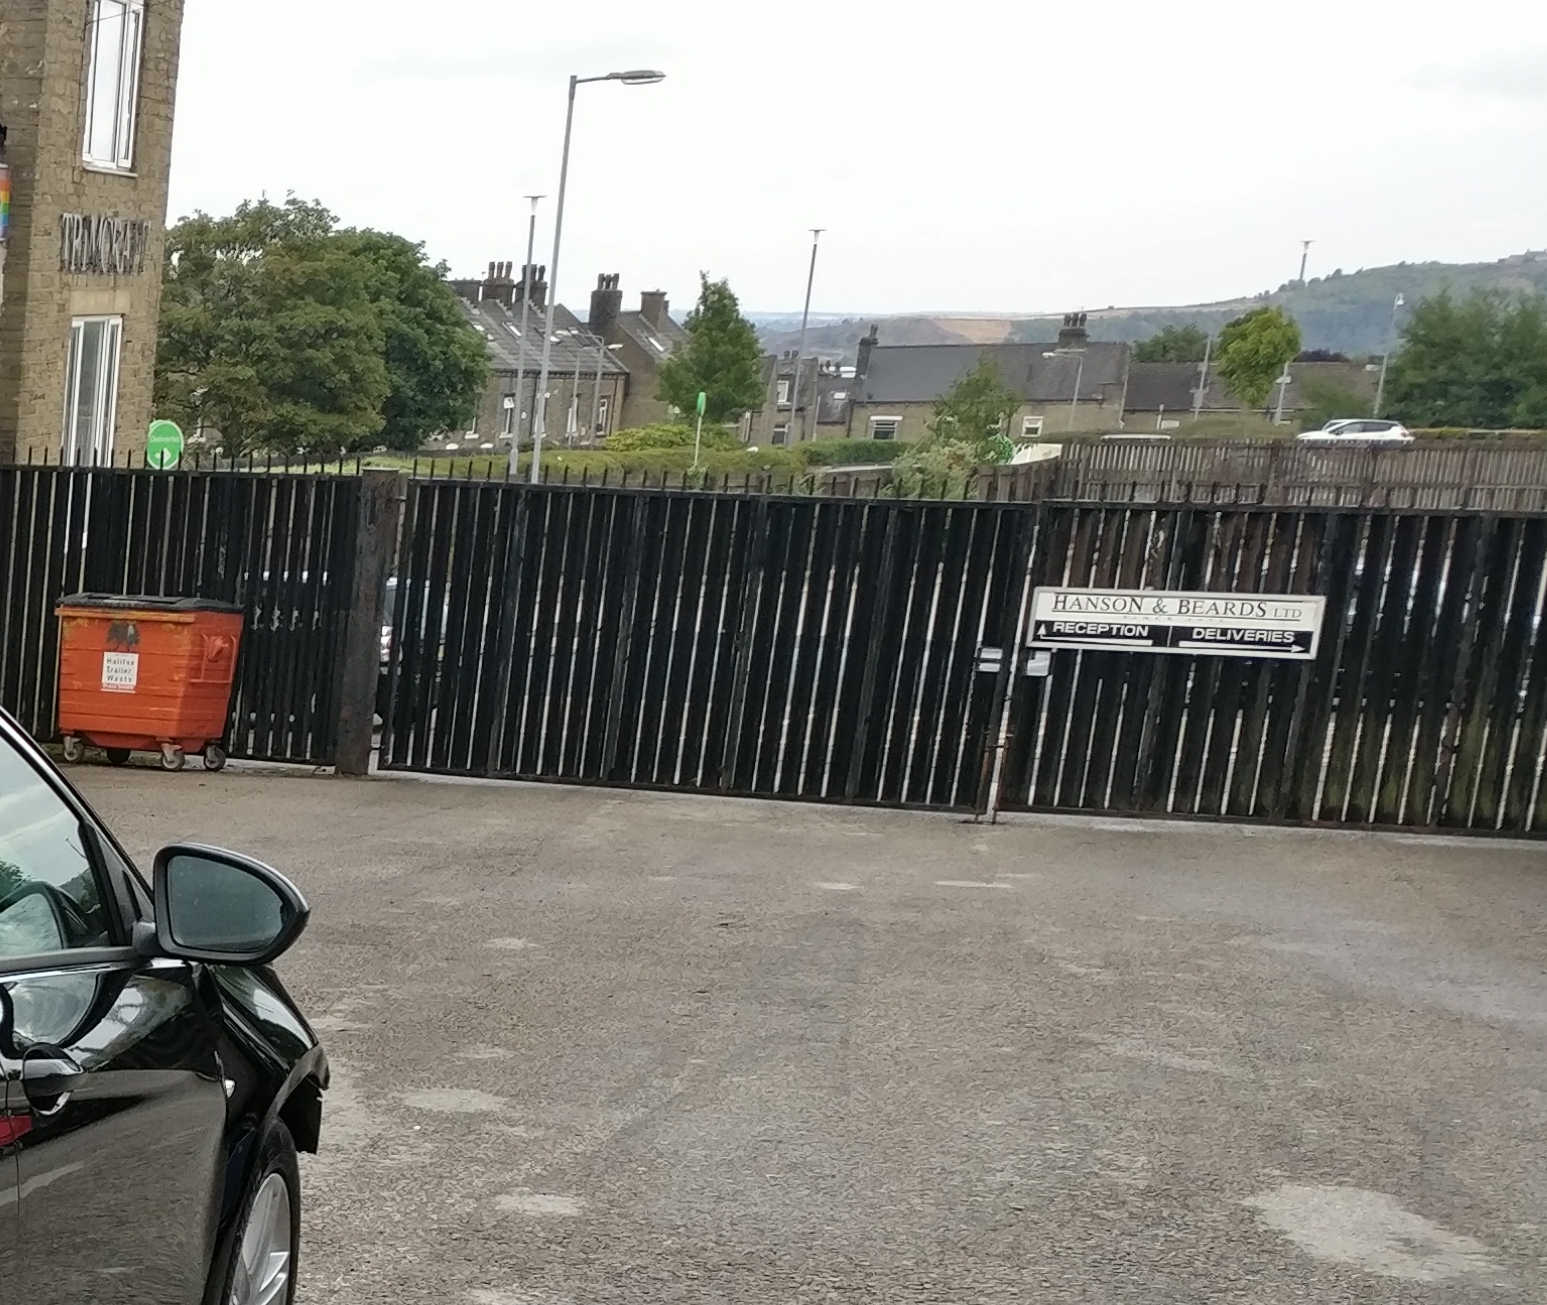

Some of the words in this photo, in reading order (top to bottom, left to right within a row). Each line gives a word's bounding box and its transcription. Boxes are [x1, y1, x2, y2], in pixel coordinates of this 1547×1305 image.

[1052, 593, 1146, 614] HANSON
[1152, 598, 1168, 614] &
[1177, 599, 1267, 618] BEARDS
[1273, 607, 1302, 619] LTD
[1052, 620, 1149, 637] RECEPTION
[1192, 627, 1296, 643] DELIVERIES
